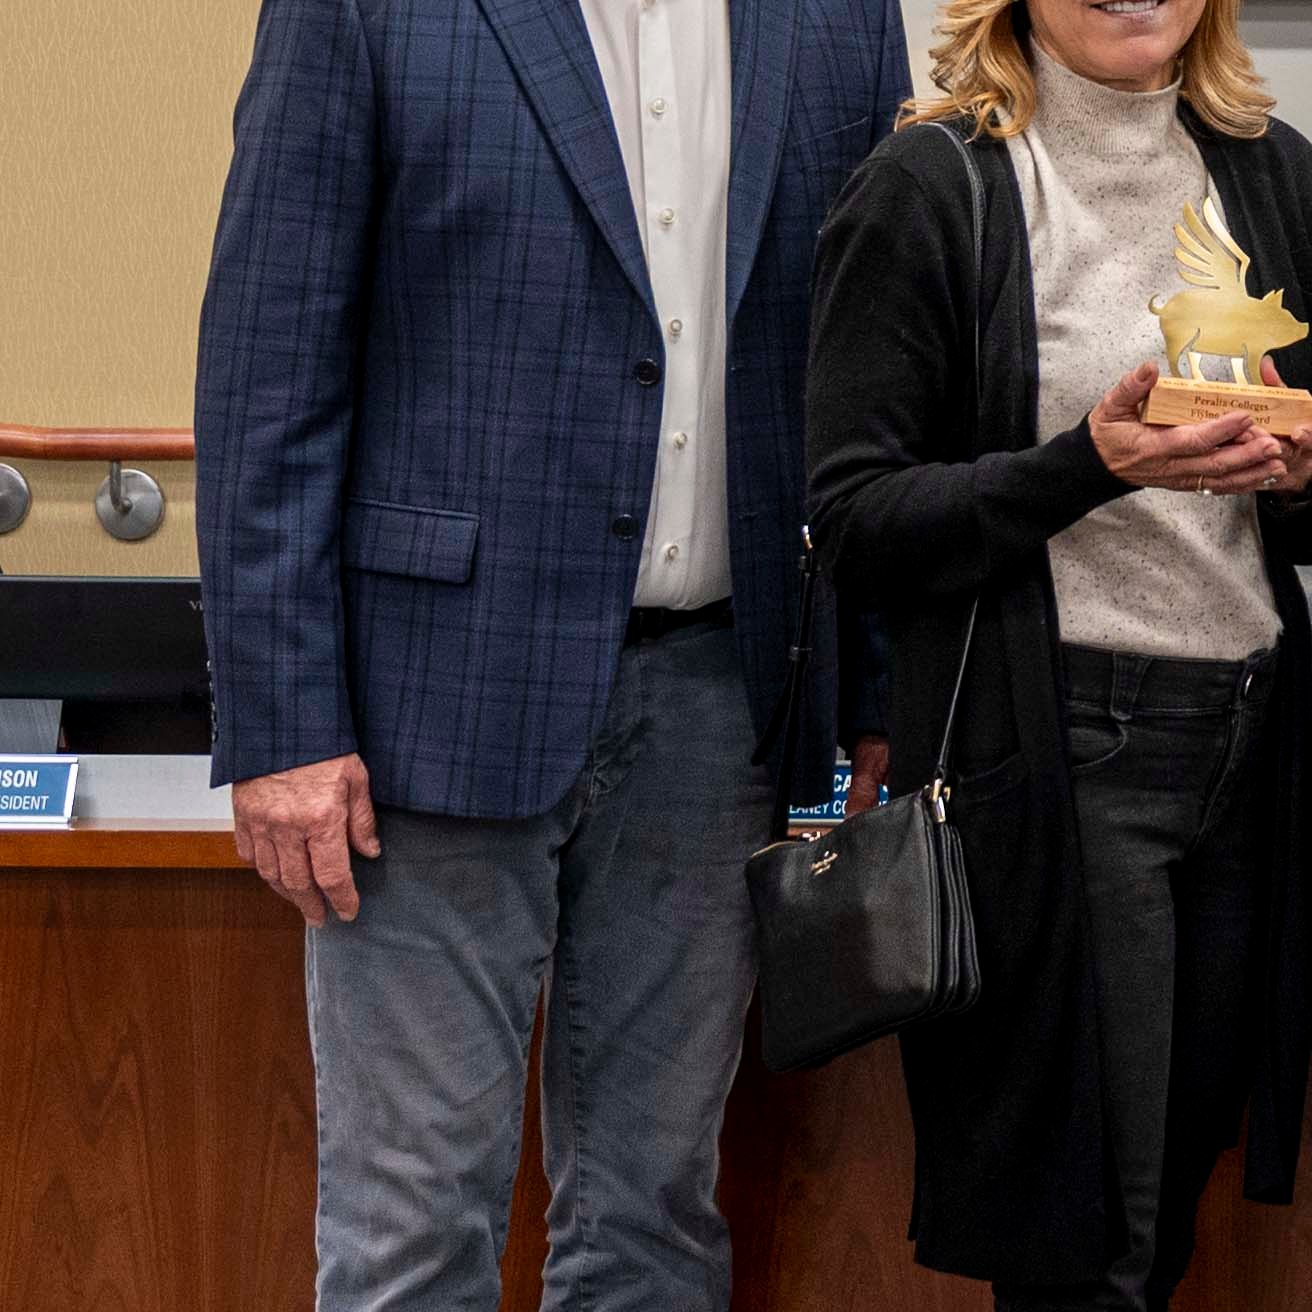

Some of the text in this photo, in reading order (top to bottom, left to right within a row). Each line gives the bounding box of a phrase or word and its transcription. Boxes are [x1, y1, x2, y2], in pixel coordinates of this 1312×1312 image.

[1194, 396, 1269, 411] Peralta Colleges
[0, 769, 38, 787] SON
[0, 795, 49, 810] SIDENT
